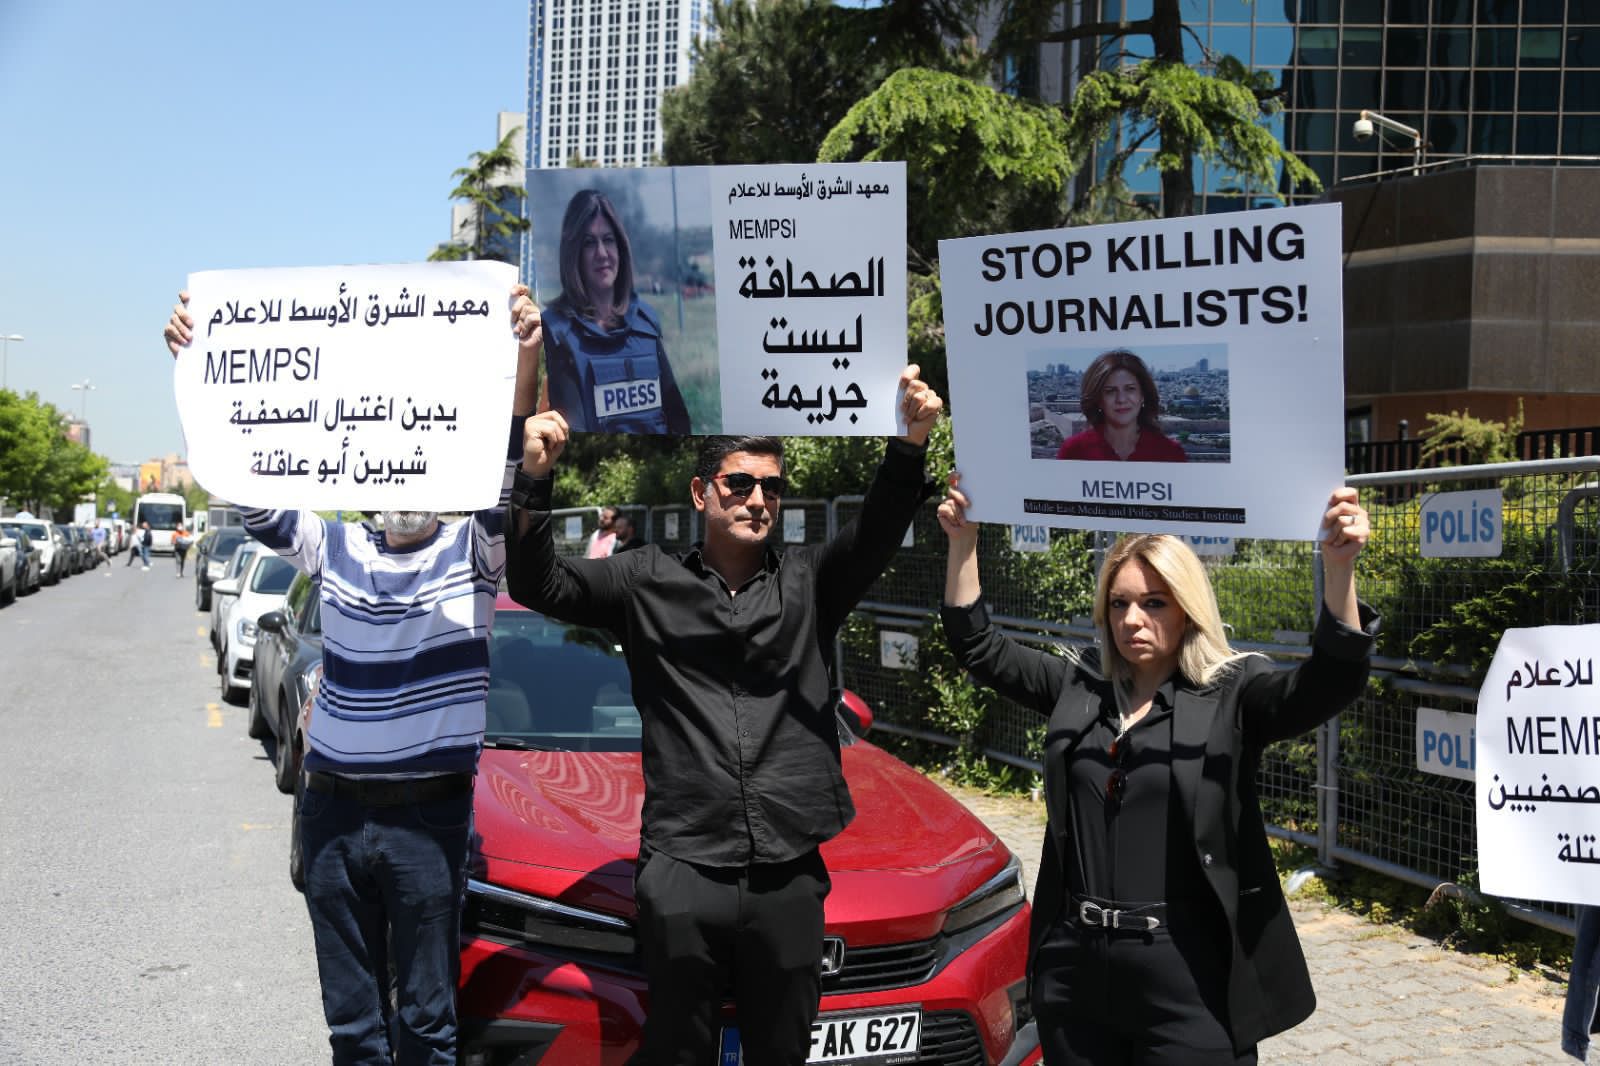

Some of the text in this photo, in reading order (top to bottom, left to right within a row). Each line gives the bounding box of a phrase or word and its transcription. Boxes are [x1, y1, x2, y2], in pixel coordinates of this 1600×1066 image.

[728, 172, 890, 205] معهد الشرق الأوسط للاعلام
[729, 218, 796, 240] MEMPSI
[981, 222, 1305, 282] STOP KILLING
[738, 255, 885, 299] الصحافة
[207, 282, 490, 337] معهد الشرق الأوسط للاعلام
[974, 284, 1308, 337] JOURNALISTS!
[762, 313, 863, 370] ليست
[204, 346, 320, 385] MEMPSI
[229, 395, 457, 434] يدين اغتيال الصحفية
[603, 382, 657, 412] PRESS
[760, 367, 868, 425] جريمة
[250, 436, 427, 485] شيرين أبو عاقلة
[1024, 501, 1245, 522] Middle East Media and Policy Studies Institute
[1081, 479, 1173, 502] MEMPSI
[1425, 499, 1495, 544] POLİS
[1506, 657, 1593, 702] للاعلام
[865, 1015, 917, 1053] 627
